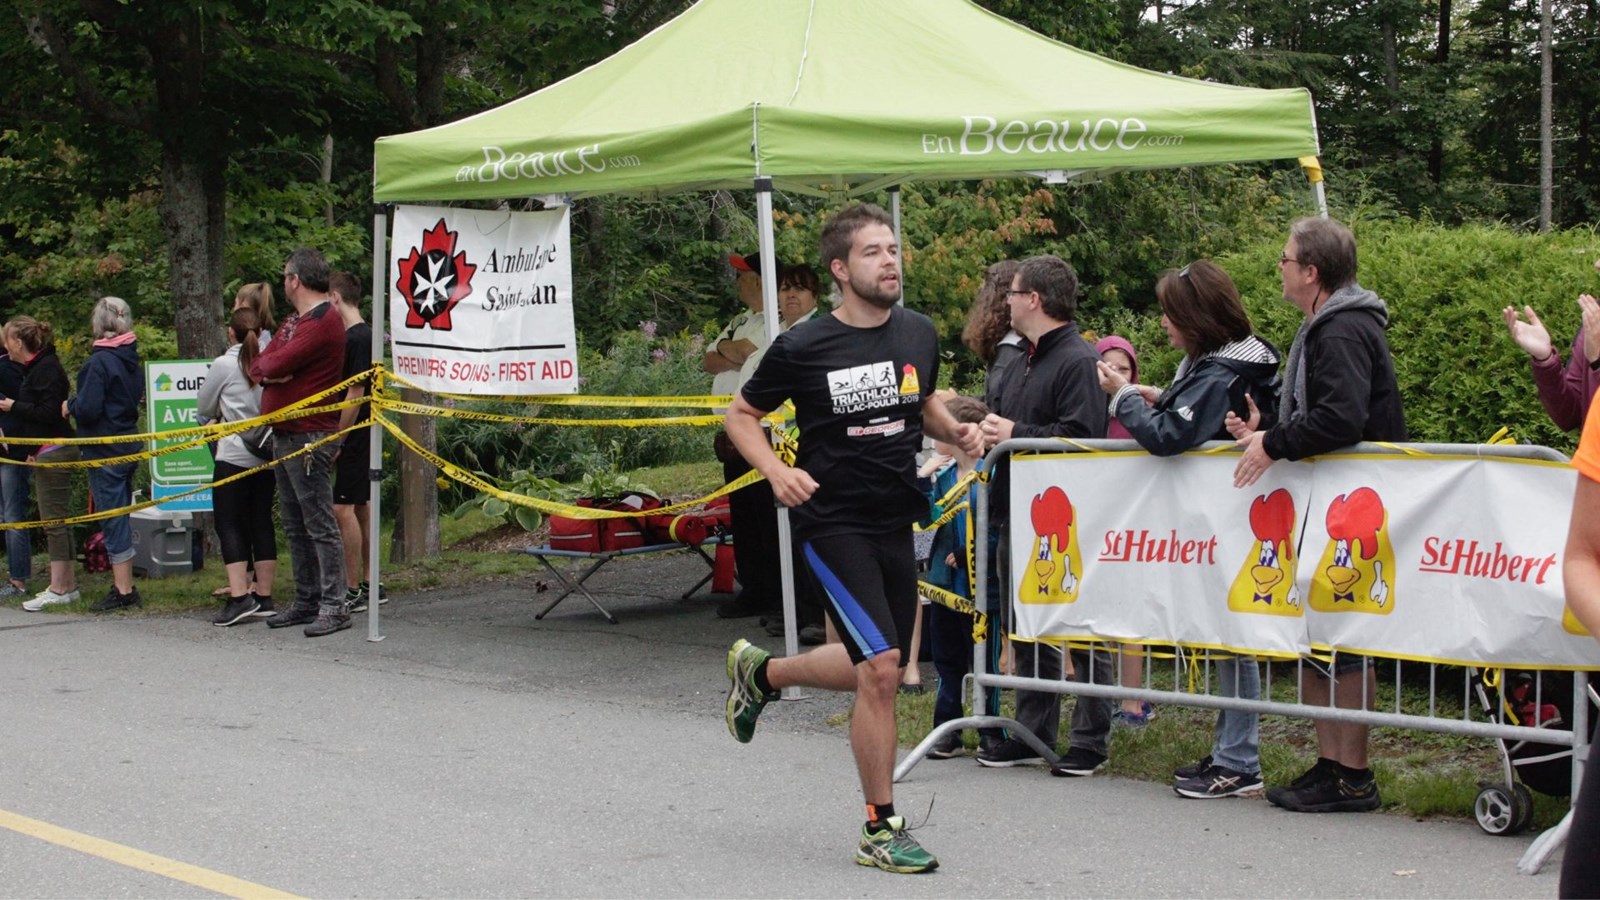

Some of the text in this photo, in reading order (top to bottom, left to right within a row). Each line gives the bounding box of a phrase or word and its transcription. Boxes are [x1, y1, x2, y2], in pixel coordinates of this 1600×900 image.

[450, 362, 490, 382] SOINS
[499, 361, 536, 382] FIRST
[541, 359, 574, 380] AID
[831, 386, 898, 406] TRIATHLON
[832, 395, 919, 415] DU LAC-POULIN 2019
[163, 405, 176, 423] À
